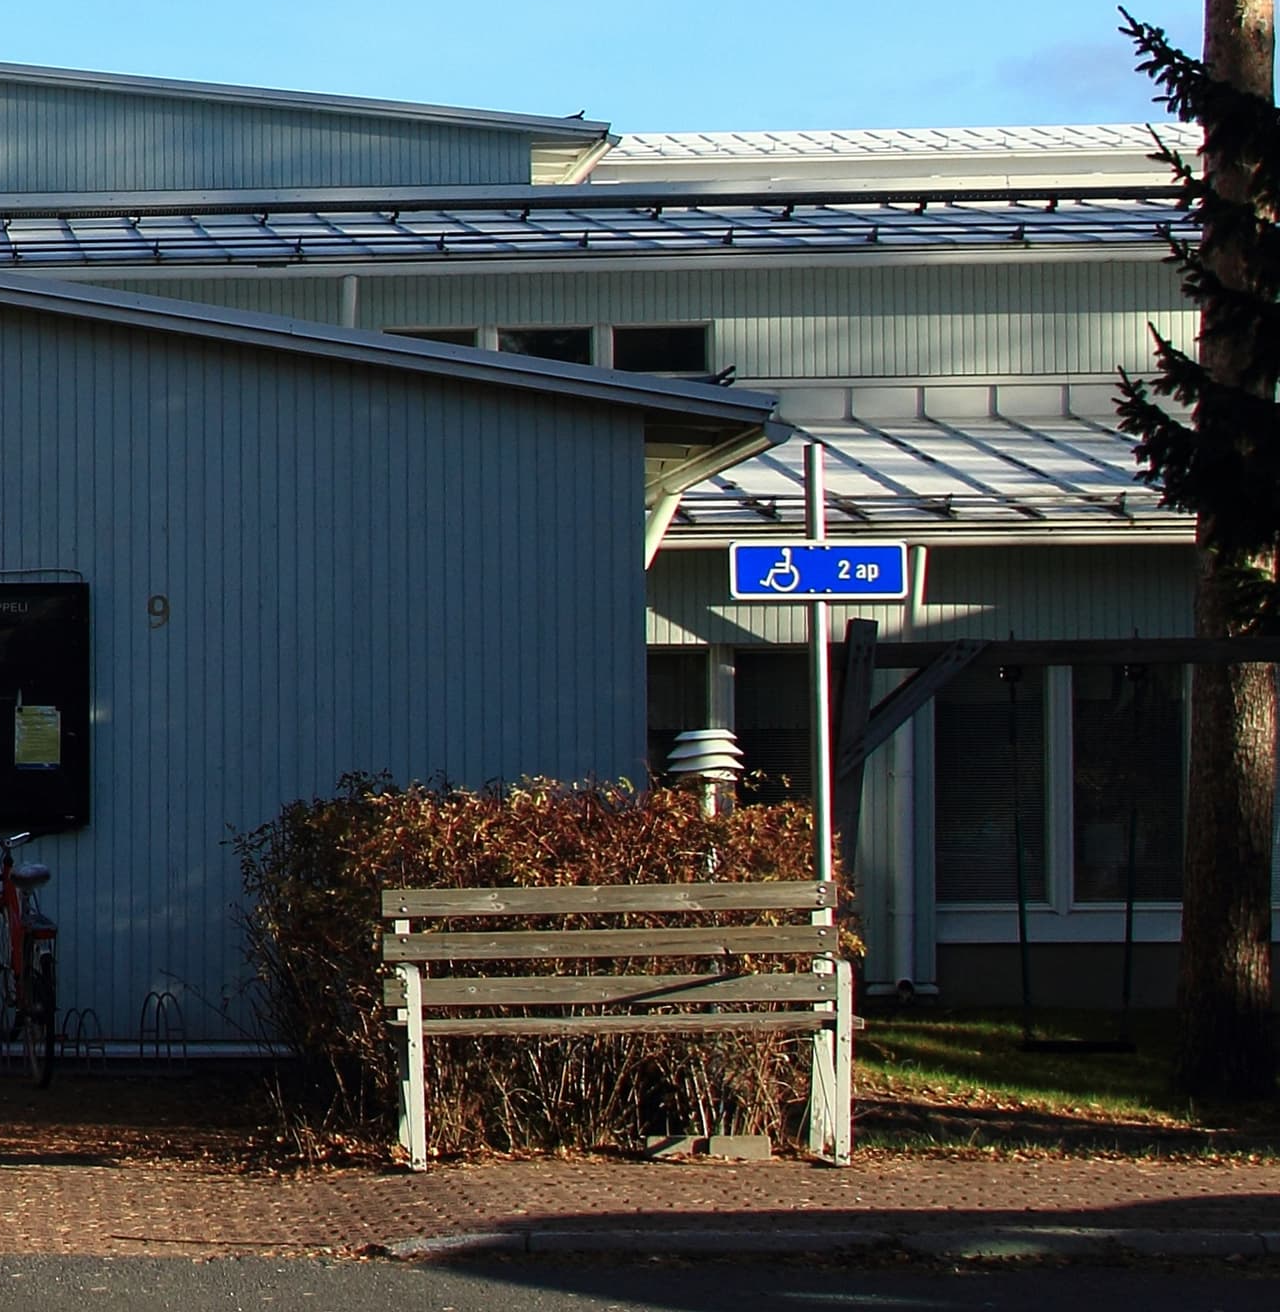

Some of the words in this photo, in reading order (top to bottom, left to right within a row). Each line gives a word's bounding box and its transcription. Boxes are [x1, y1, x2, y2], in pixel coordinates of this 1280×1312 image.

[838, 559, 851, 579] 2
[855, 563, 880, 583] ap
[148, 594, 170, 630] 9
